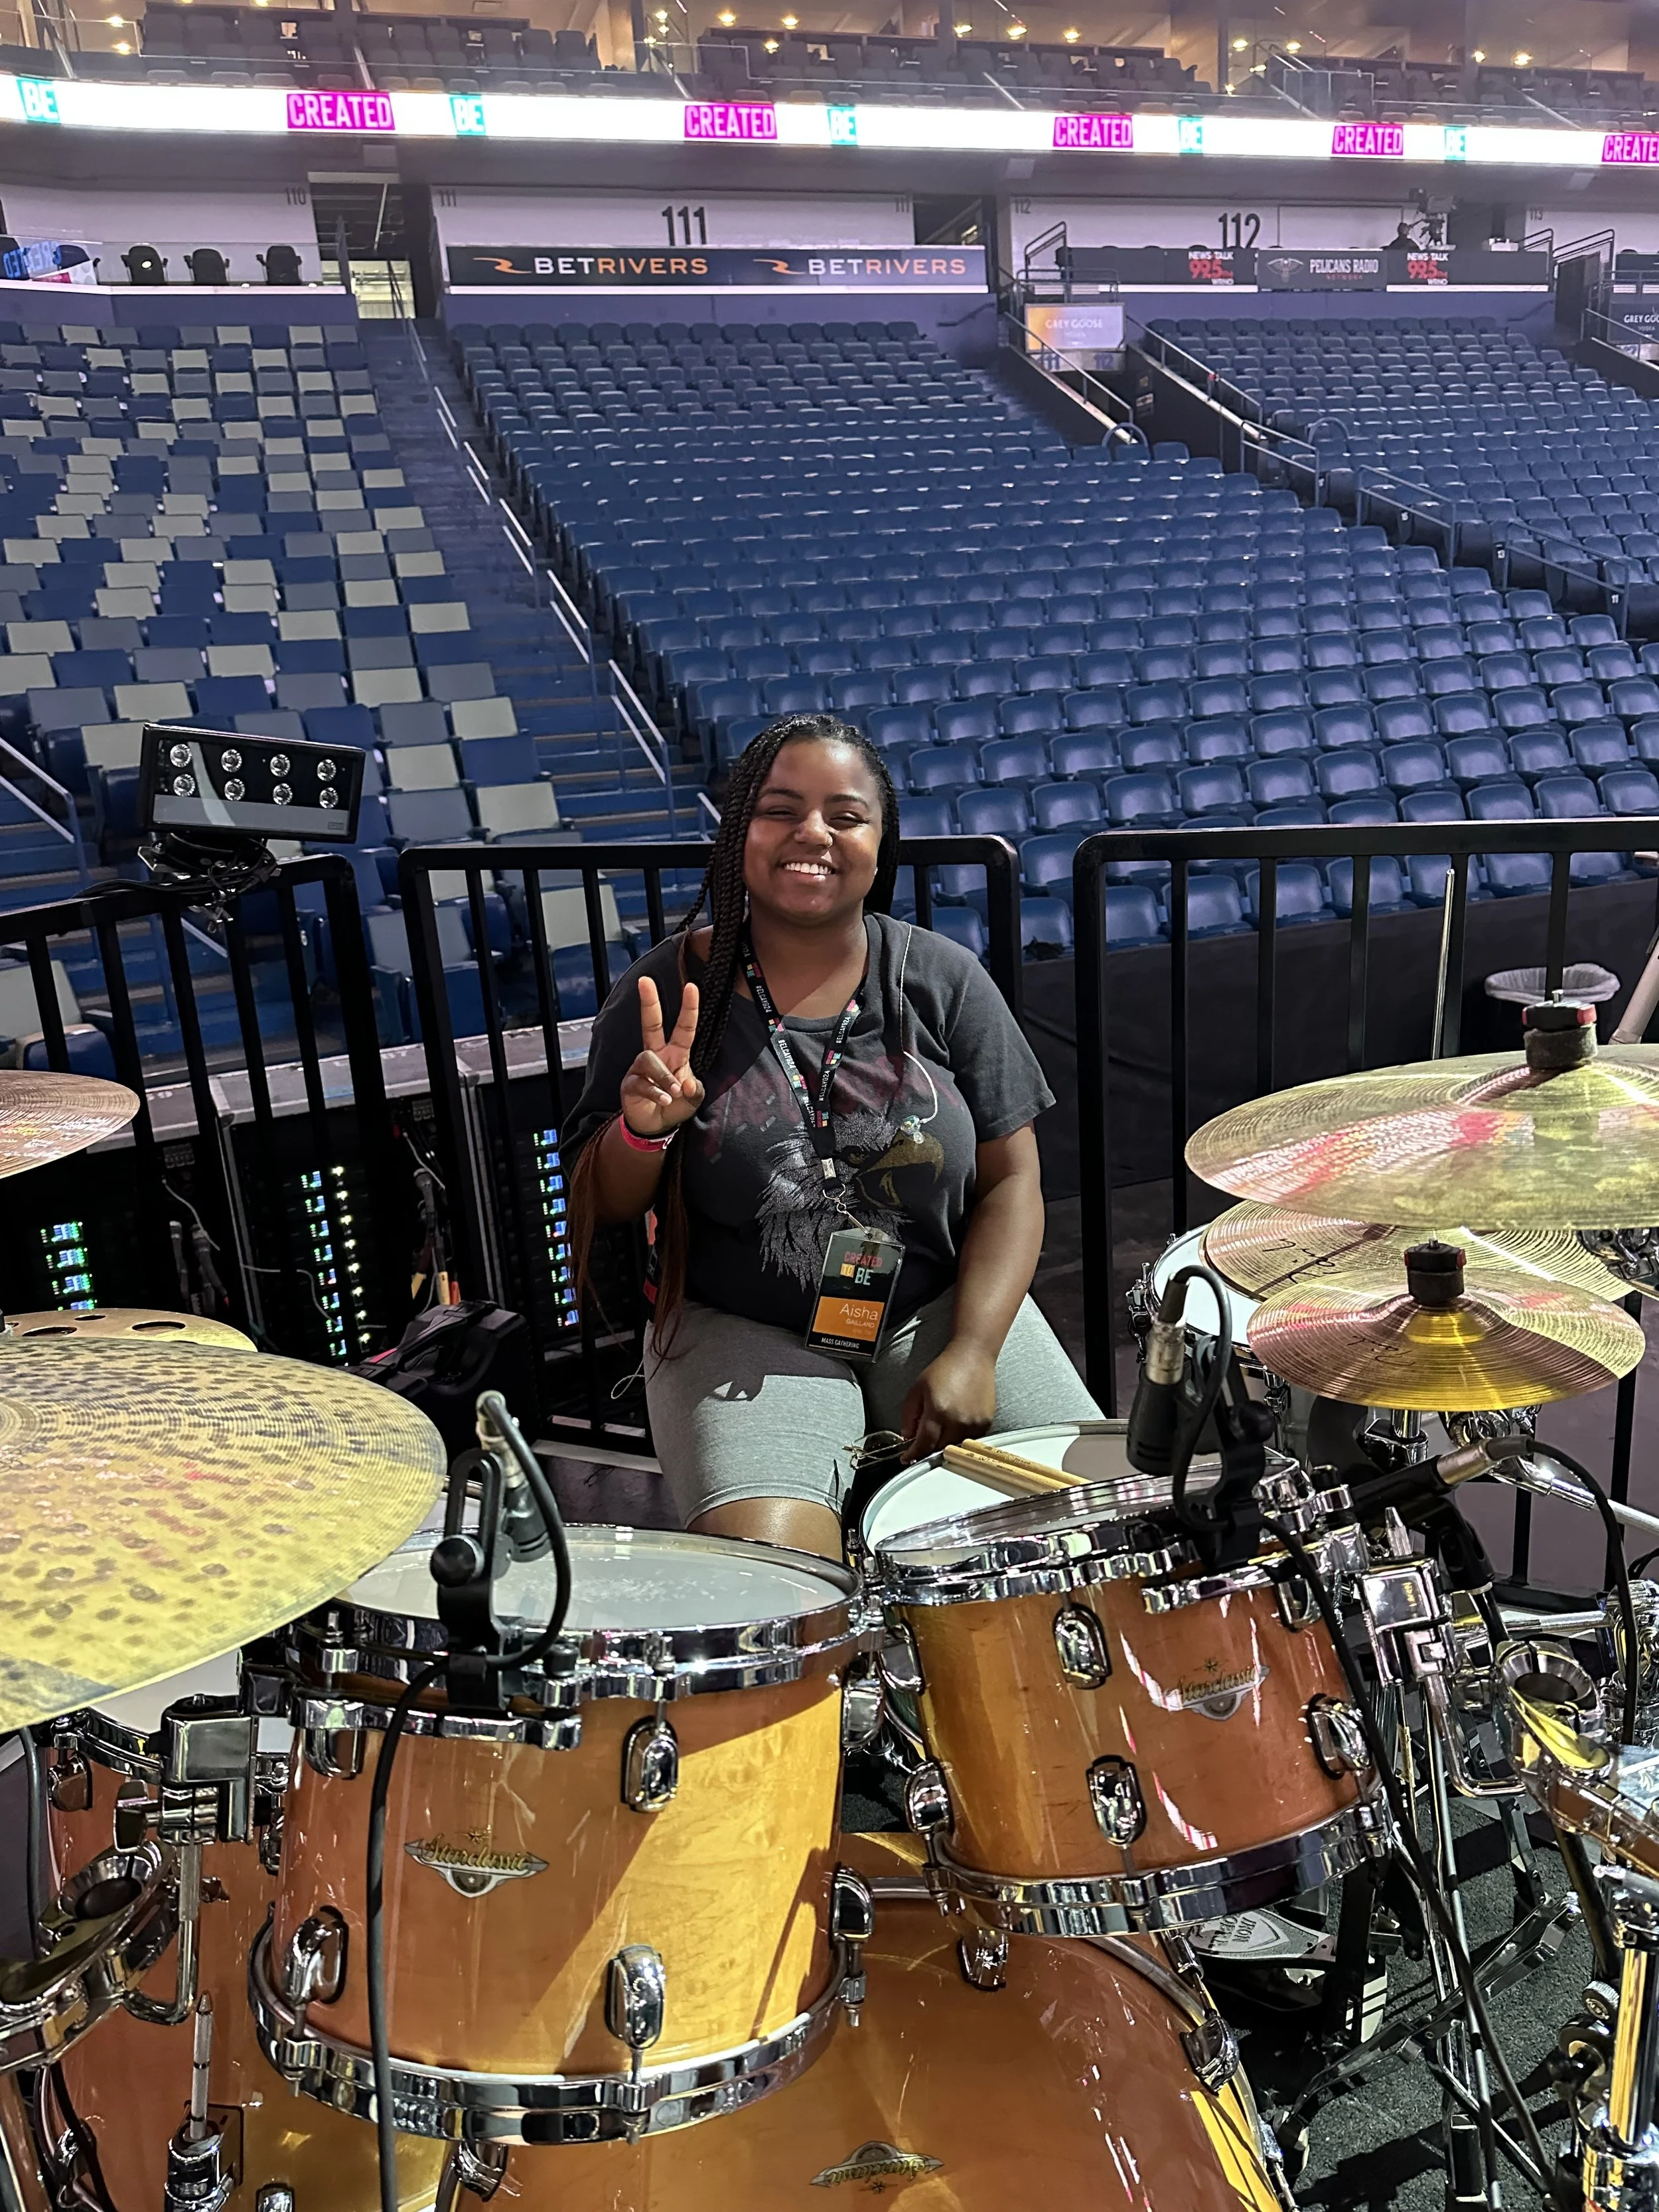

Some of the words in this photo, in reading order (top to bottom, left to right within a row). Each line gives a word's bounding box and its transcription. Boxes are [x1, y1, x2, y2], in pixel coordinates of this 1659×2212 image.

[21, 80, 59, 119] BE
[289, 94, 393, 127] CREATED
[453, 98, 485, 133] BE
[685, 106, 776, 137] CREATED
[830, 109, 857, 141] BE
[1054, 117, 1133, 147] CREATED
[1180, 119, 1202, 150] BE
[1333, 126, 1404, 154] CREATED
[1603, 135, 1659, 161] CREATE
[285, 188, 307, 206] 110
[662, 206, 707, 246] 111
[1218, 212, 1261, 250] 112
[534, 258, 709, 274] BETRIVERS
[808, 258, 967, 275] BETRIVERS
[1188, 251, 1212, 260] NEWS
[1214, 251, 1234, 260] TALK
[1309, 258, 1351, 273] PELICANS
[1353, 258, 1379, 273] RADIO
[1407, 252, 1429, 261] NEWS
[1430, 252, 1449, 261] TALK
[1624, 315, 1644, 323] GREY
[844, 1252, 883, 1267] CREATED
[842, 1264, 853, 1276] TO
[854, 1267, 875, 1286] BE
[839, 1303, 879, 1321] Aisha
[834, 1339, 860, 1349] GATHERING
